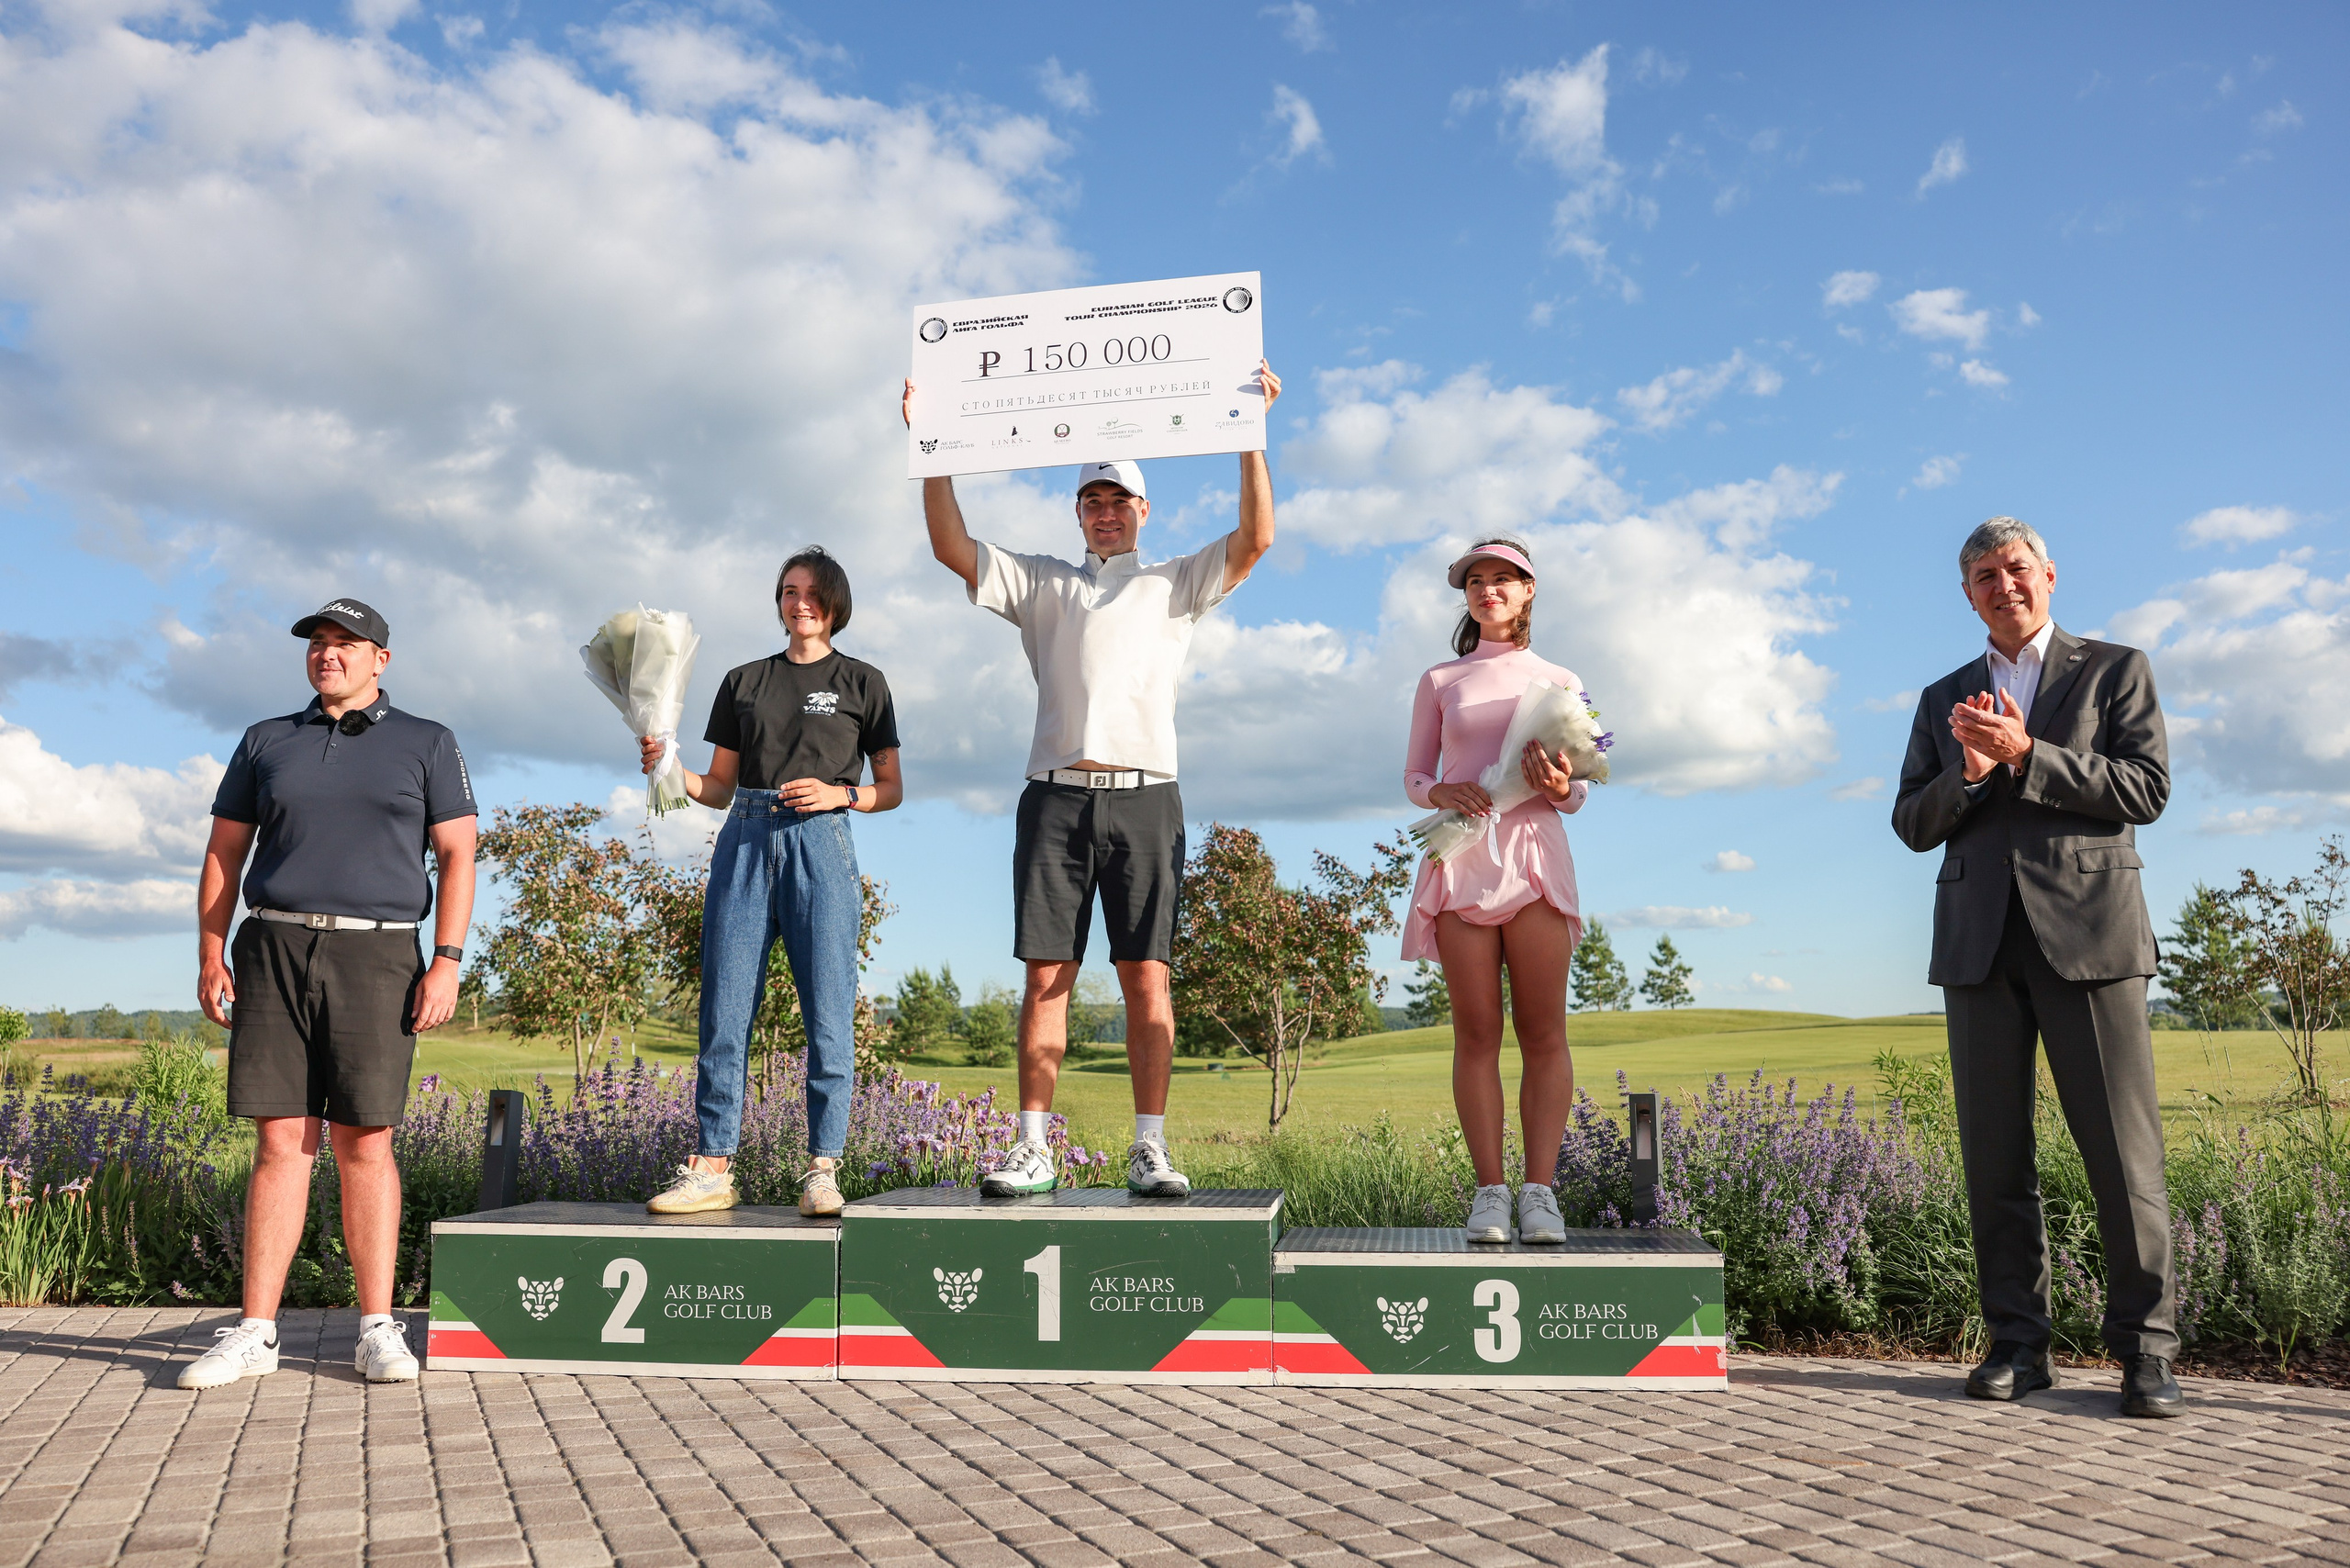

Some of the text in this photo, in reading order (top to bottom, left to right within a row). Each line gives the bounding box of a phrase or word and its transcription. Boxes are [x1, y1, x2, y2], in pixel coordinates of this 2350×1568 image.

[1091, 303, 1145, 312] EURASIAN
[1178, 296, 1218, 304] LEAGUE
[952, 314, 1029, 327] ЕВРАЗИЙСКАЯ
[1064, 313, 1095, 321] TOUR
[1098, 306, 1182, 318] CHAMPIONSHIP
[980, 321, 1024, 330] ГОЛЬФА
[1024, 342, 1088, 373] 150
[1103, 334, 1171, 365] 000
[962, 380, 1211, 411] СТО ПЯТЬДЕСЯТ ТЫСЯЧ РУБЛЕЙ
[991, 437, 1024, 446] LINKS
[802, 705, 836, 713] VANS
[454, 748, 471, 800] J.LINDEBERG
[312, 913, 328, 927] FJ
[664, 1284, 744, 1301] AK BARS
[1024, 1245, 1061, 1341] 1
[1090, 1277, 1175, 1293] AK BARS
[600, 1257, 648, 1343] 2
[1090, 1296, 1204, 1313] GOLF CLUB
[664, 1303, 772, 1320] GOLF CLUB
[1539, 1304, 1628, 1319] AK BARS
[1472, 1279, 1522, 1363] 3
[1539, 1324, 1658, 1340] GOLF CLUB
